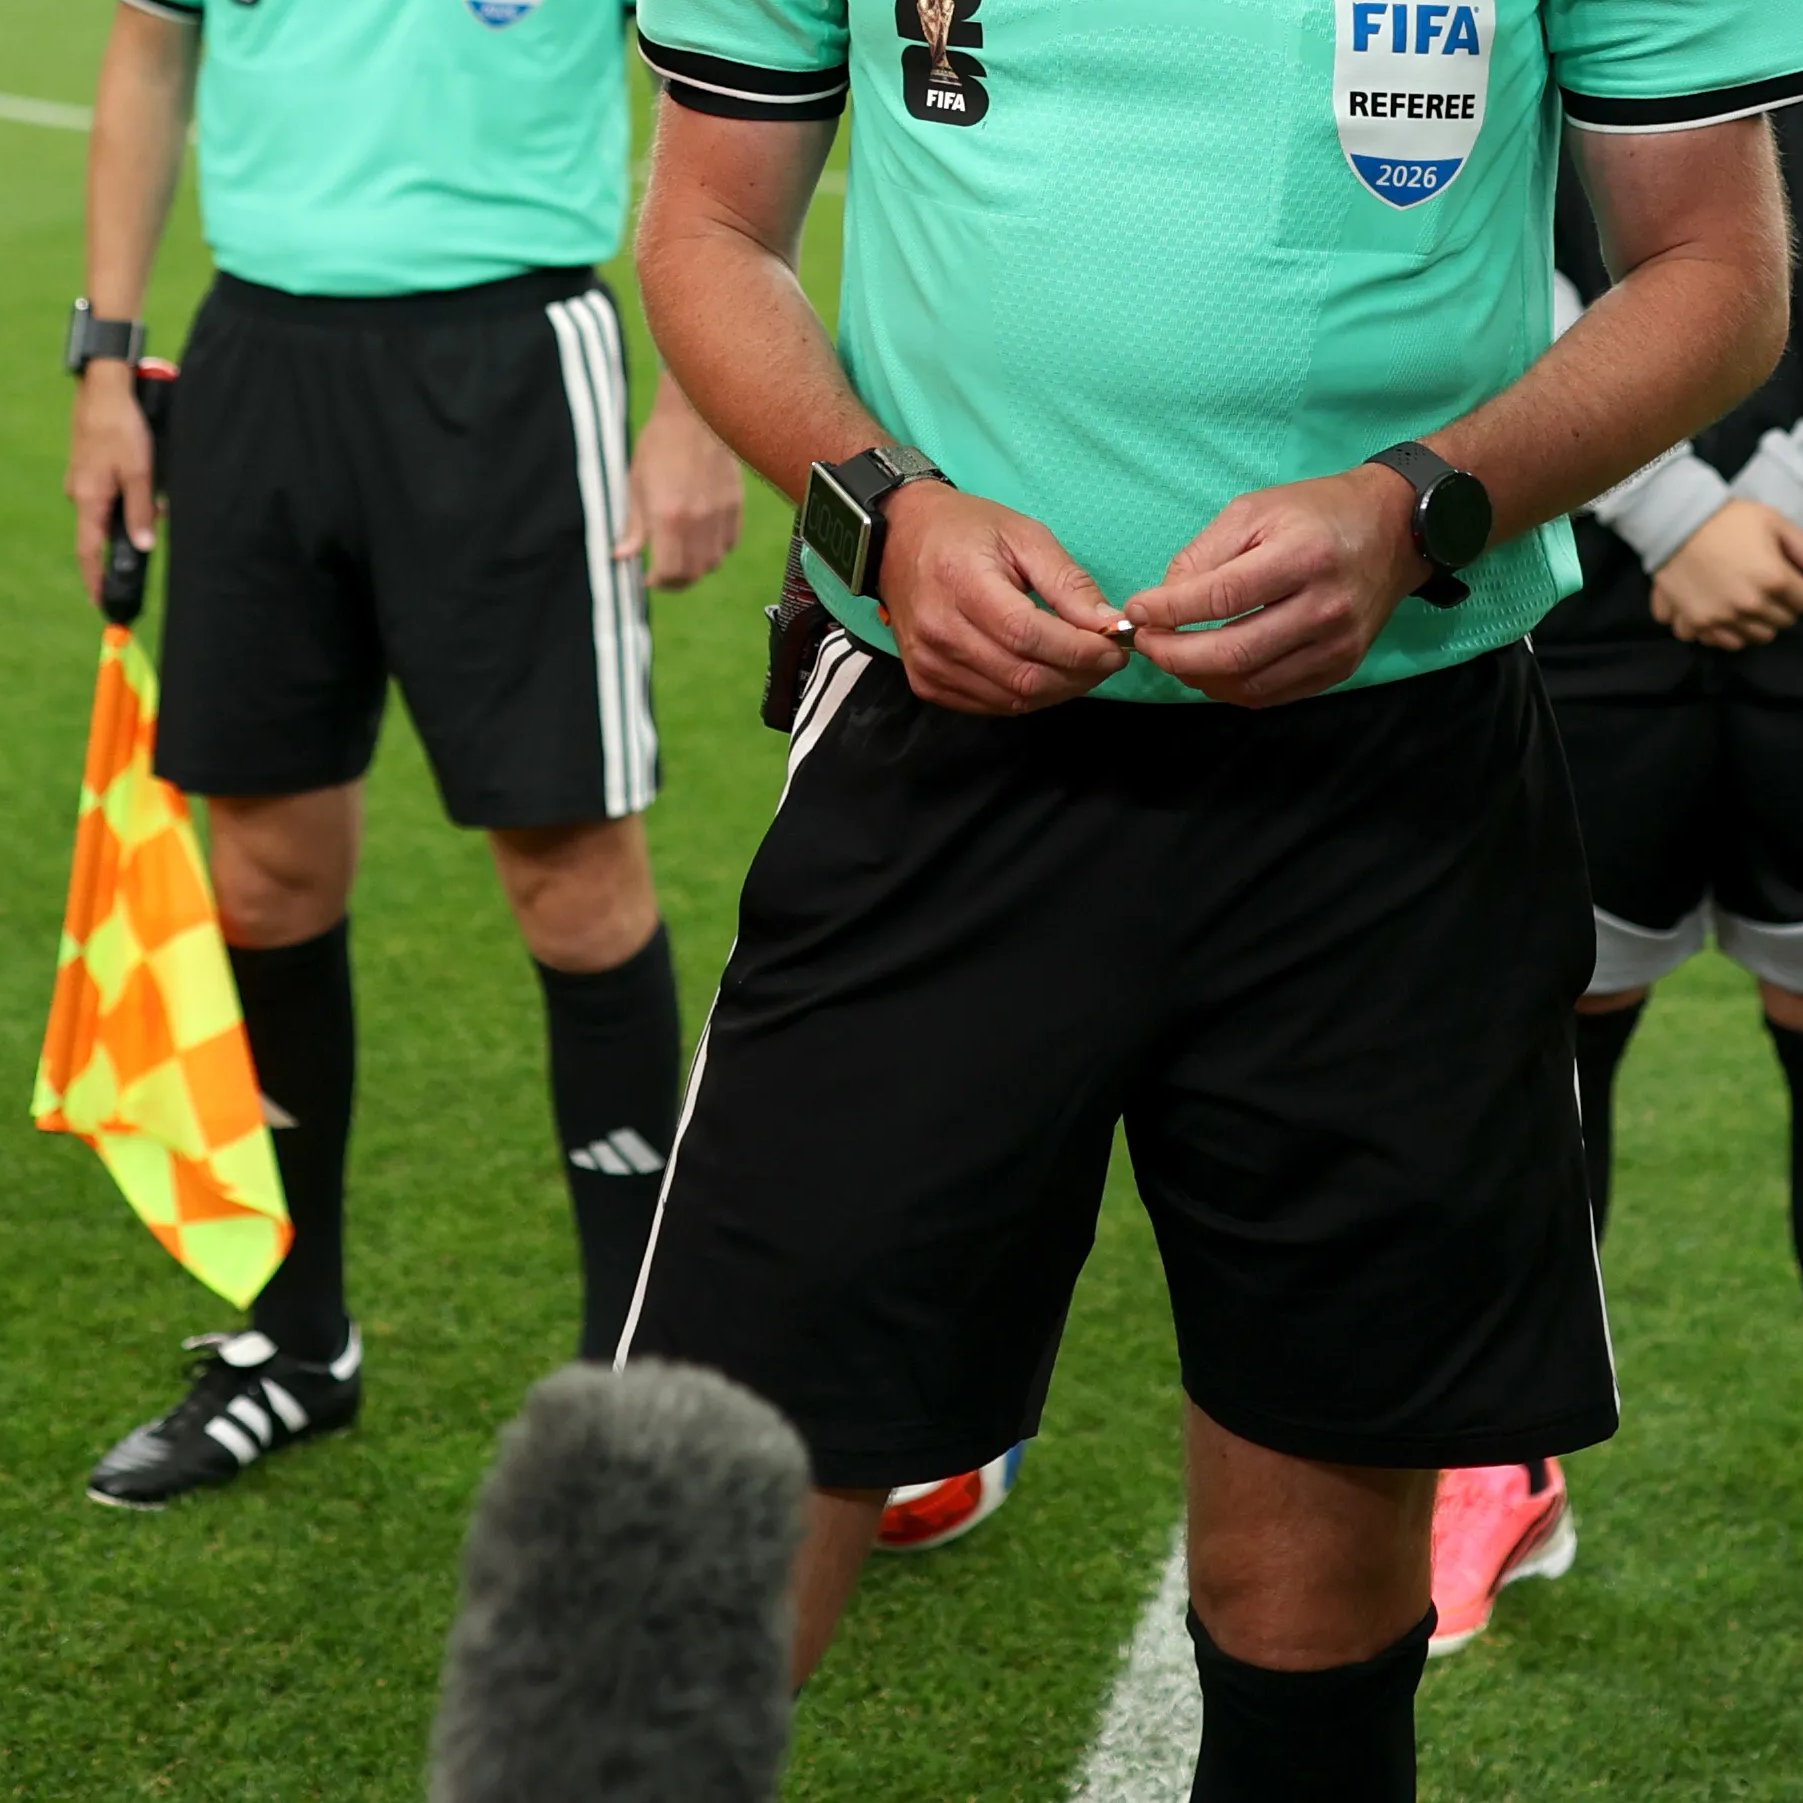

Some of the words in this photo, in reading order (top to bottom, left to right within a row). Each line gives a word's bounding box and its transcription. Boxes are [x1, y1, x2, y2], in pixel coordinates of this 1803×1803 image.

[1352, 2, 1480, 56] FIFA
[925, 88, 966, 113] FIFA
[1349, 91, 1476, 120] REFEREE
[1375, 164, 1438, 189] 2026
